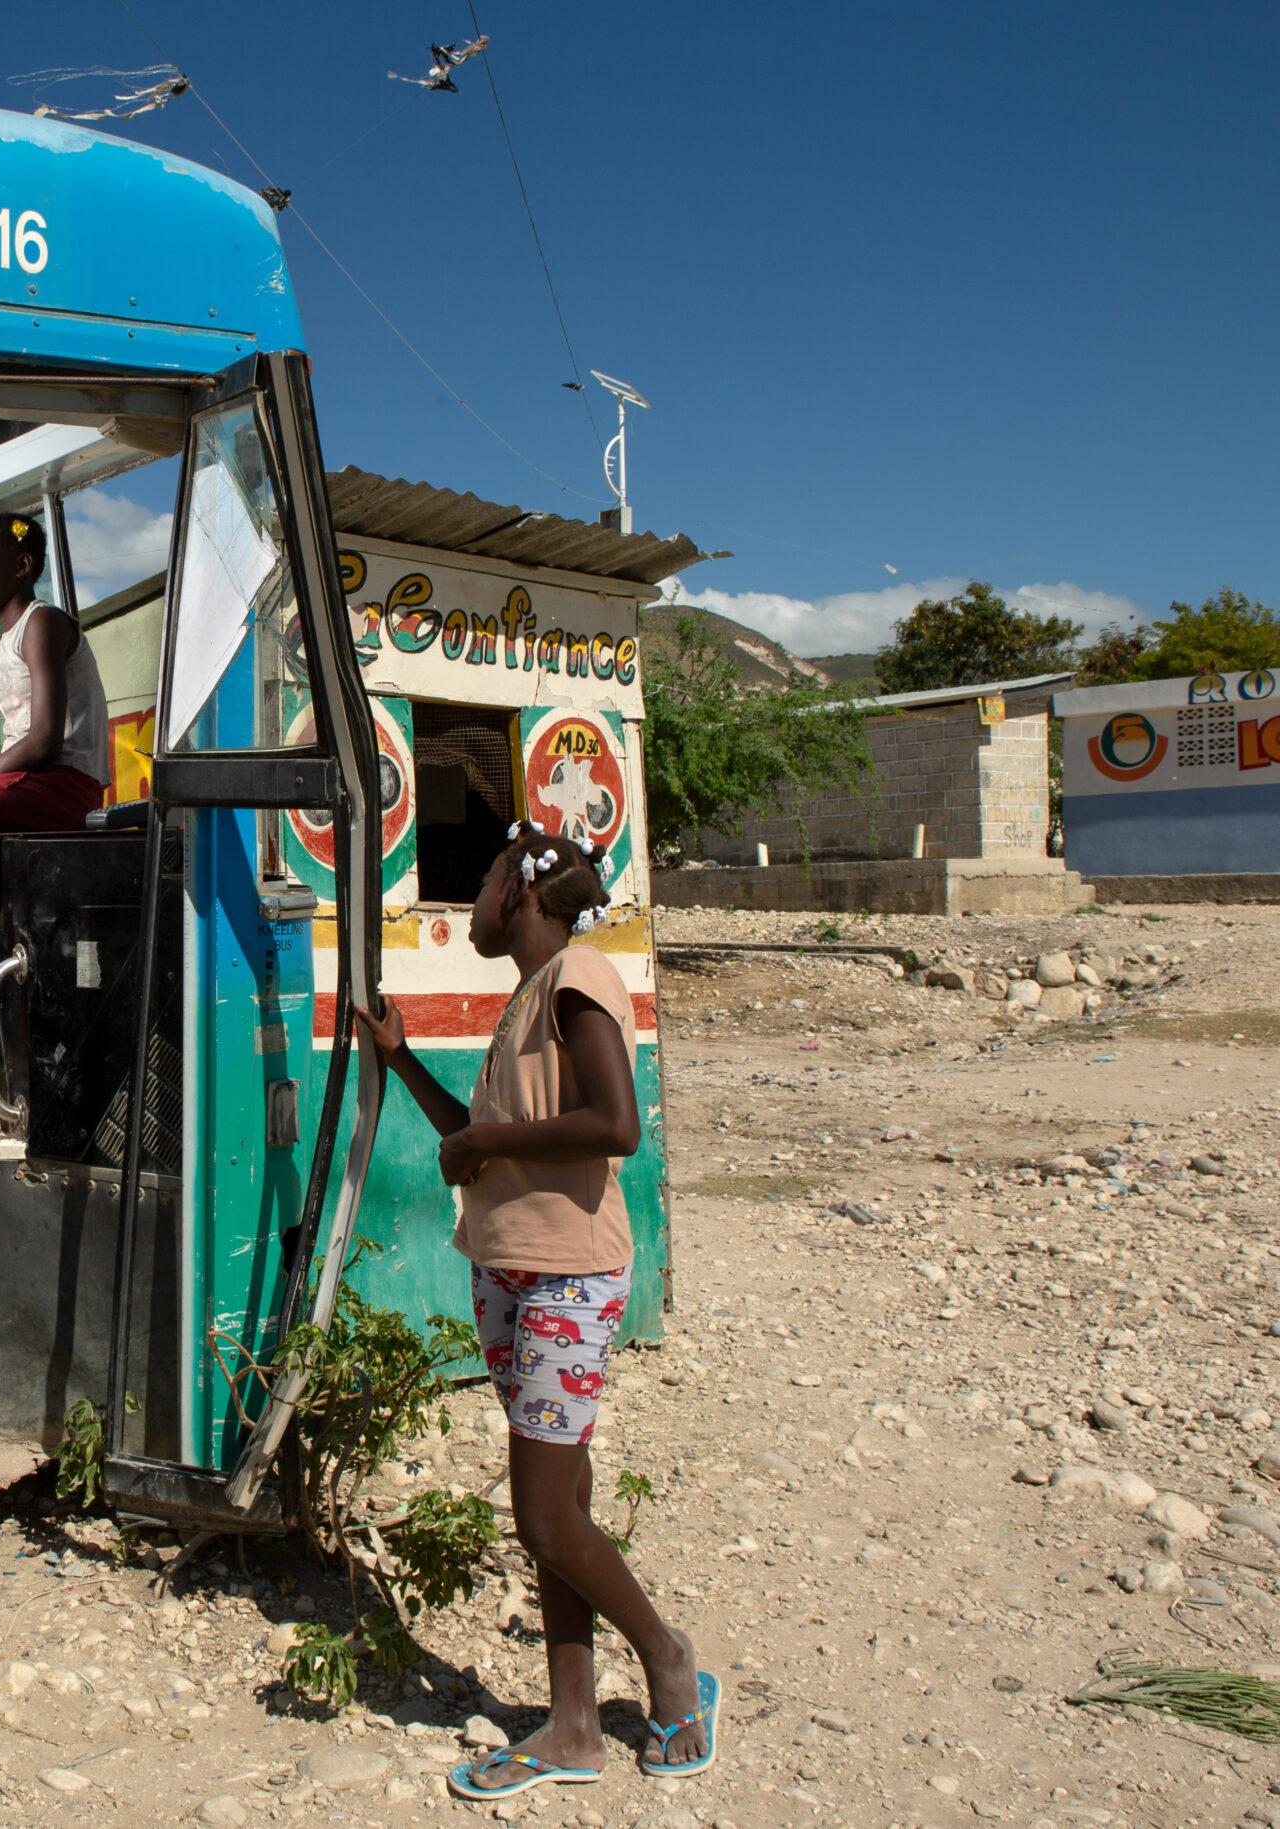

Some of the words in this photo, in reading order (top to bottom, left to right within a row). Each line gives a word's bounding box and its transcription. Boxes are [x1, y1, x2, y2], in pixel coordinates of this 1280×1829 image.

[385, 573, 637, 686] Confiance
[258, 922, 303, 936] KNEELING
[274, 939, 293, 951] BUS
[543, 1321, 560, 1332] 36
